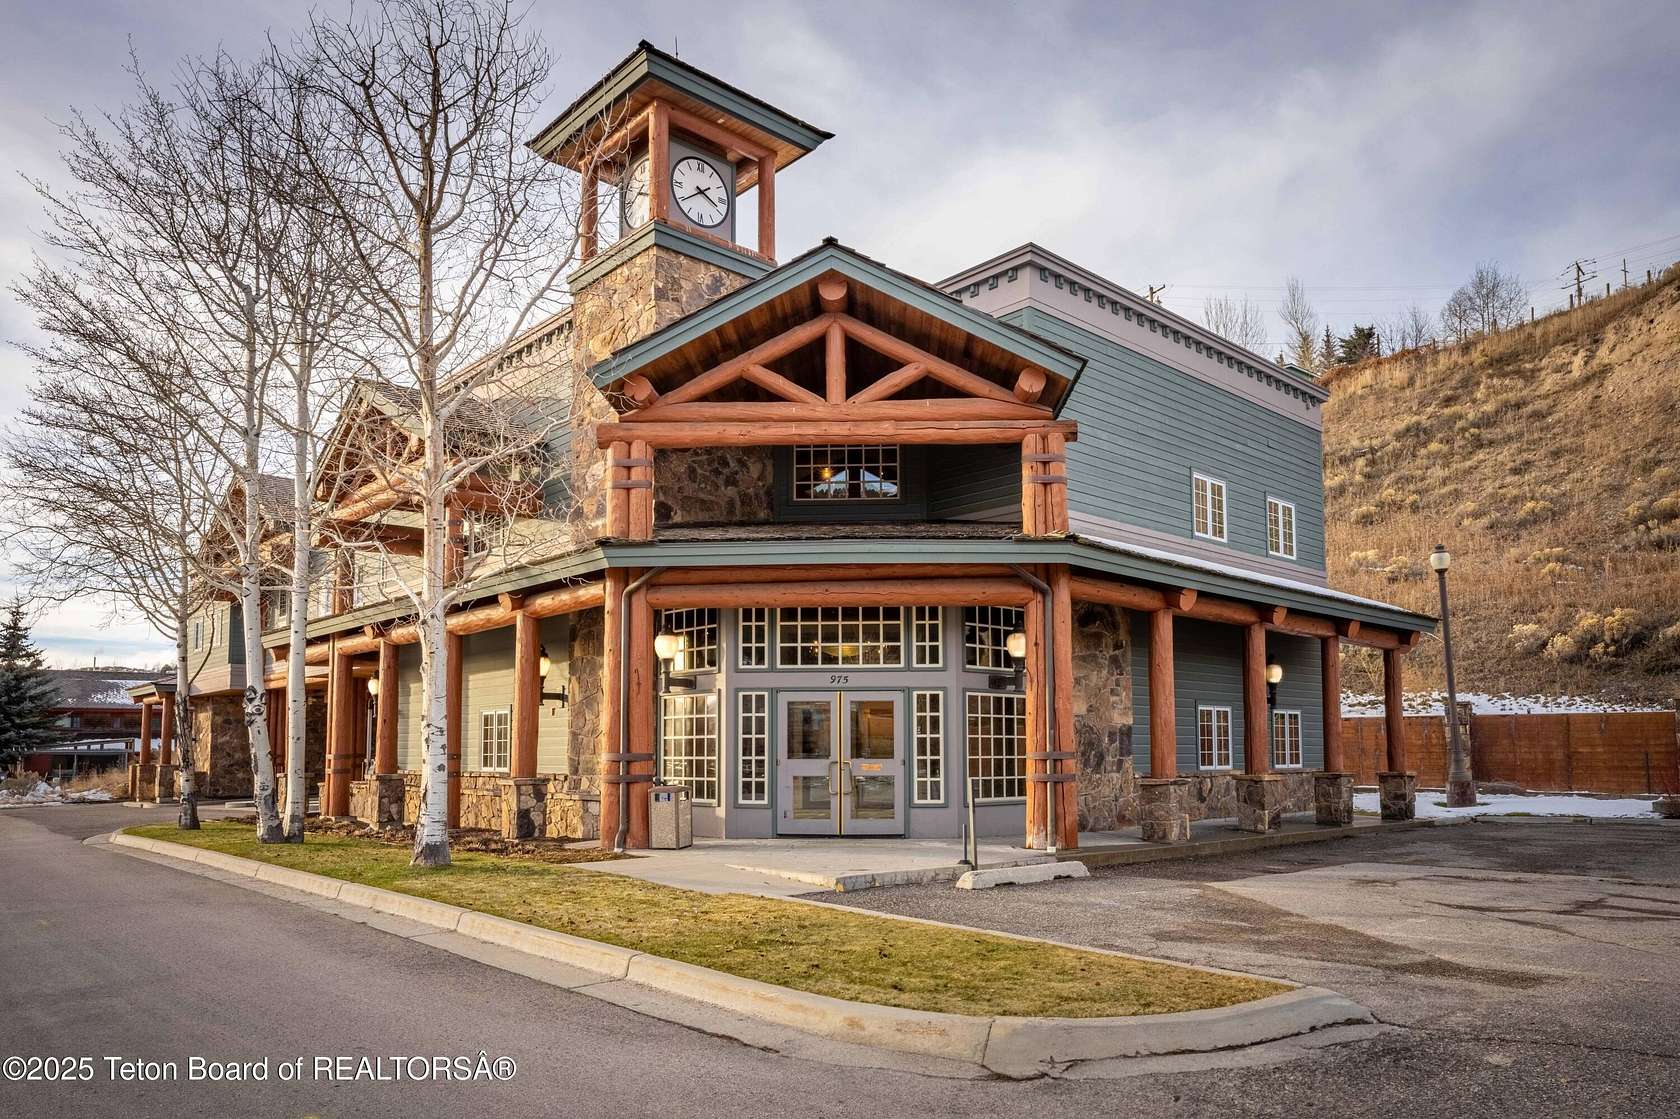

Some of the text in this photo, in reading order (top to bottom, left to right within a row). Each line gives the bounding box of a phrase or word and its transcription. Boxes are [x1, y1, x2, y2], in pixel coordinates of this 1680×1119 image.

[697, 161, 705, 173] XII
[673, 179, 683, 189] IX
[718, 197, 727, 205] III
[697, 212, 704, 224] VI
[830, 675, 849, 684] 975
